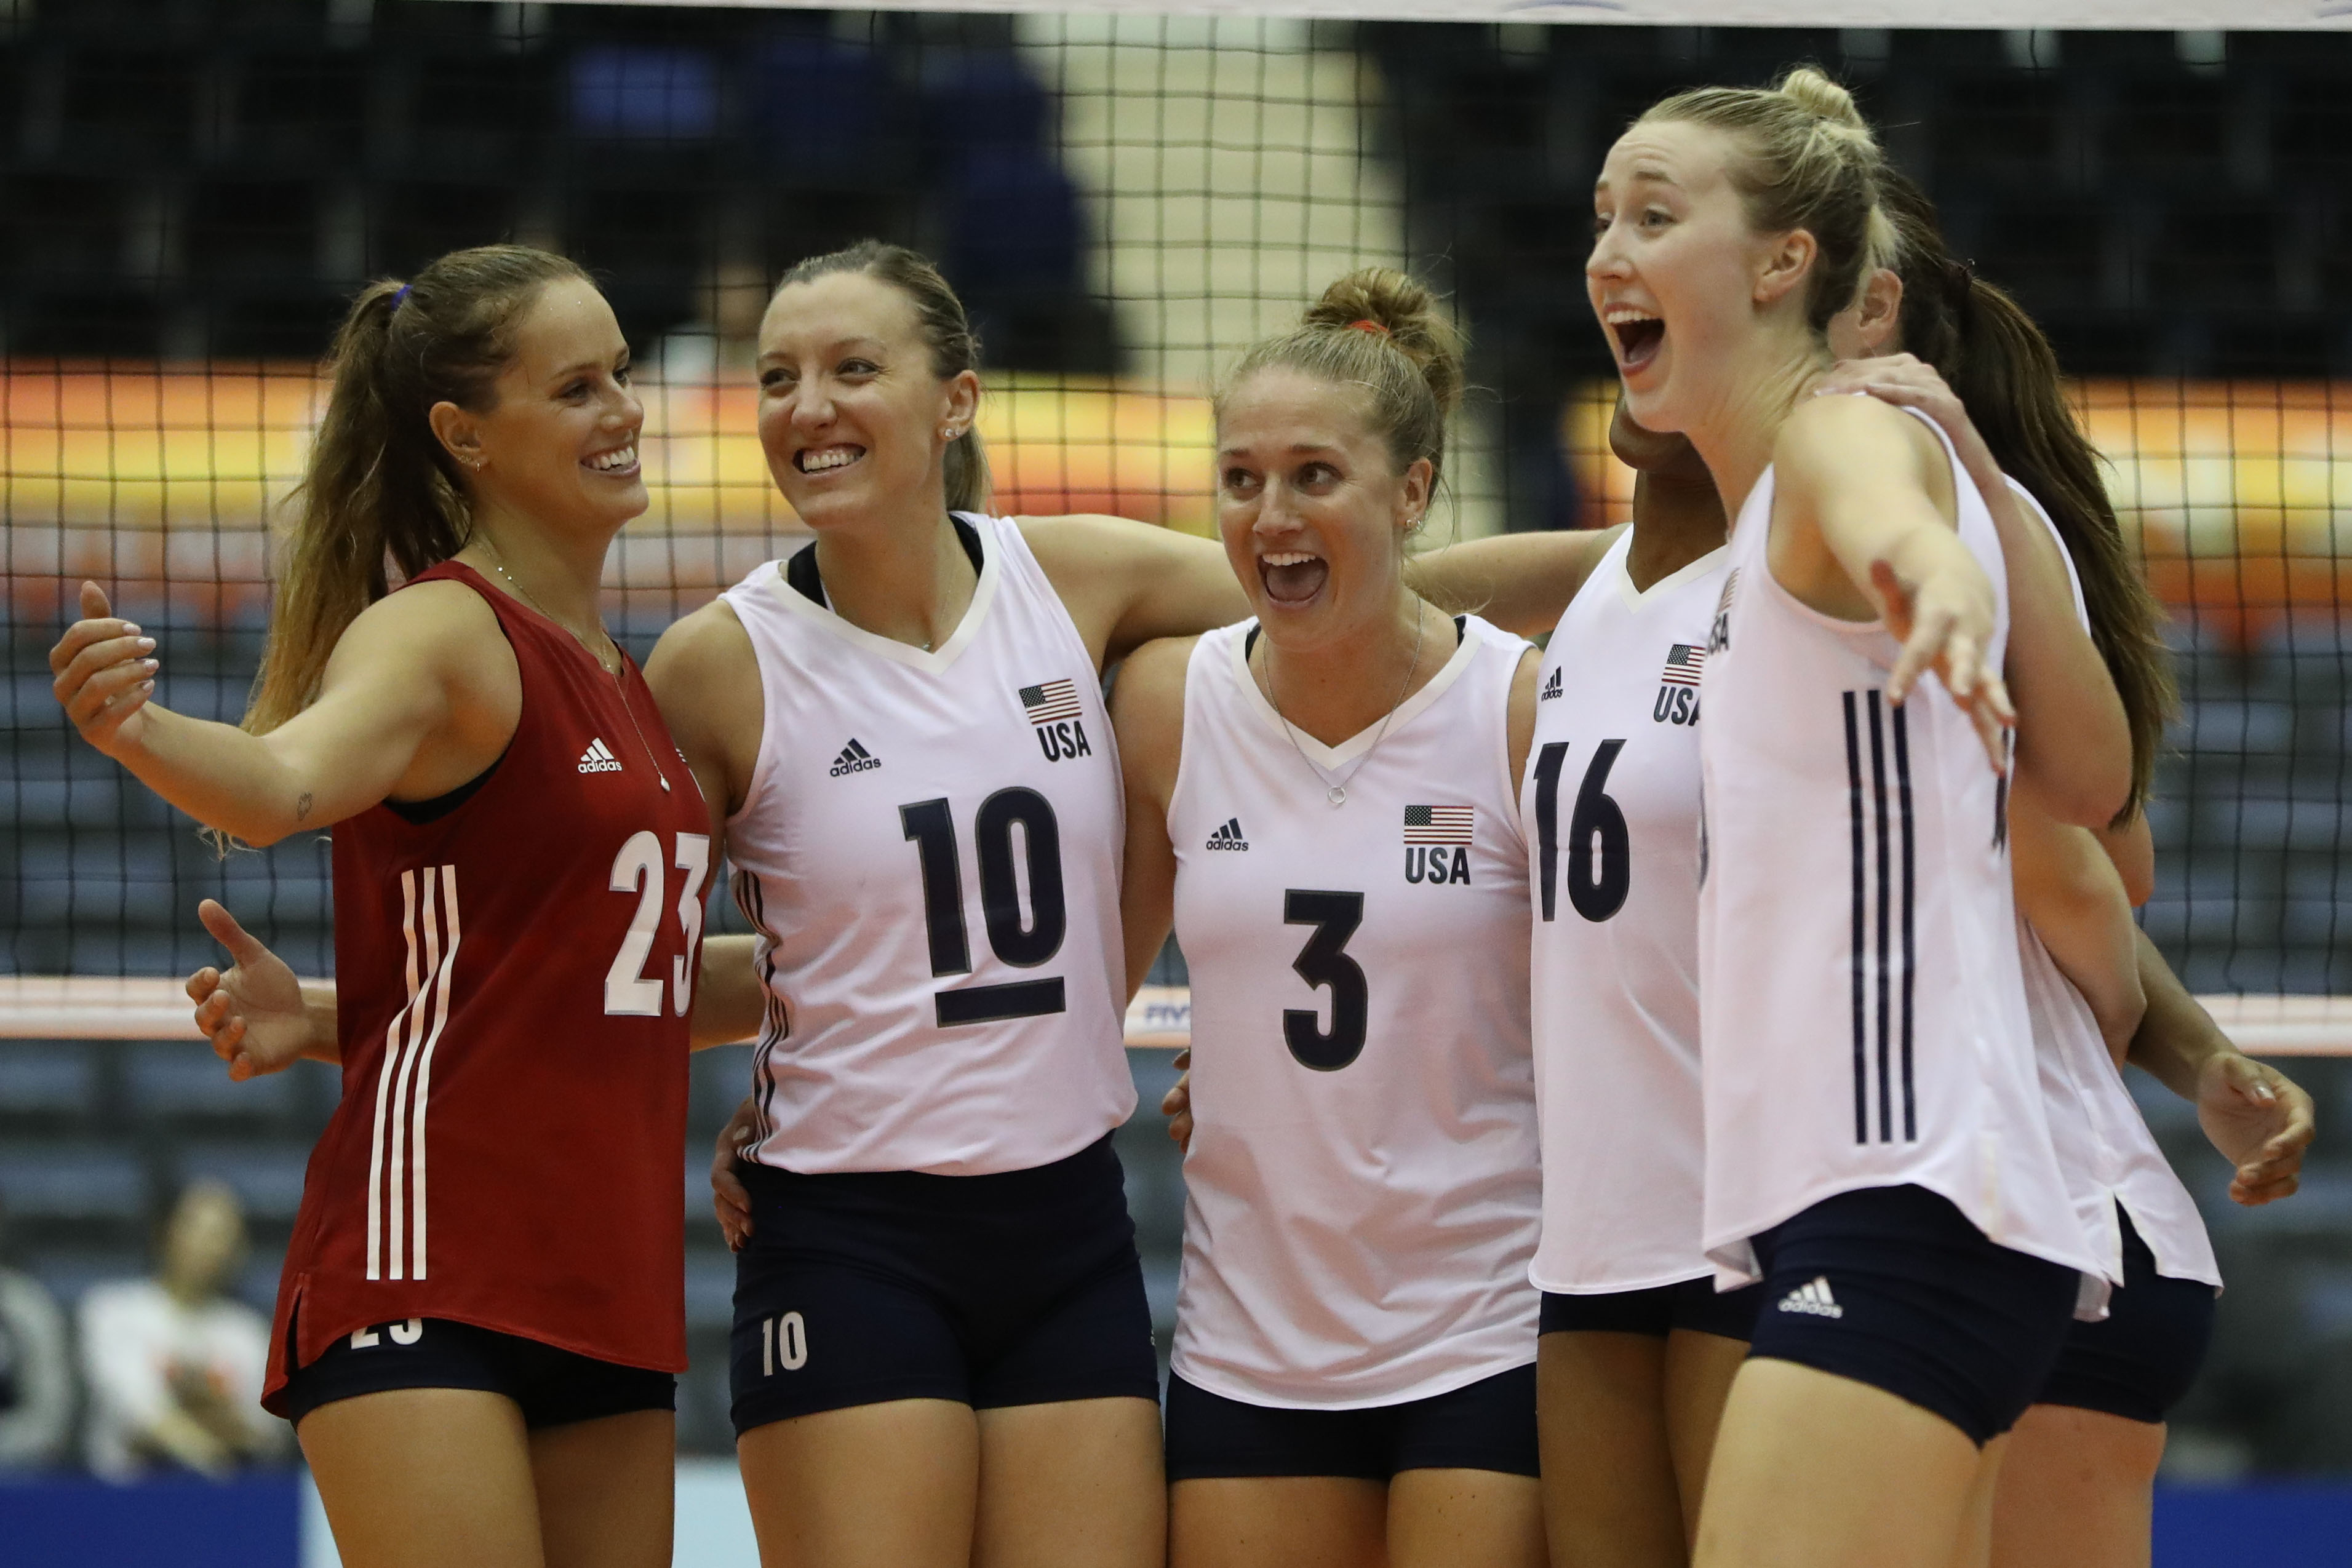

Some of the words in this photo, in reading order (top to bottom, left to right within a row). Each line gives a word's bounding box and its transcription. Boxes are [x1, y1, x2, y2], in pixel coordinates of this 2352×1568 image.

[1707, 612, 1729, 656] SA
[1036, 720, 1092, 762] USA
[578, 760, 623, 773] adidas
[830, 758, 882, 778] adidas
[1206, 838, 1250, 851] adidas
[1533, 739, 1630, 922] 16
[898, 786, 1067, 978] 10
[1405, 847, 1471, 885] USA
[604, 830, 710, 1017] 23
[1283, 889, 1368, 1072] 3
[1145, 1005, 1191, 1024] FIV
[1777, 1298, 1843, 1319] adidas
[762, 1311, 808, 1377] 10
